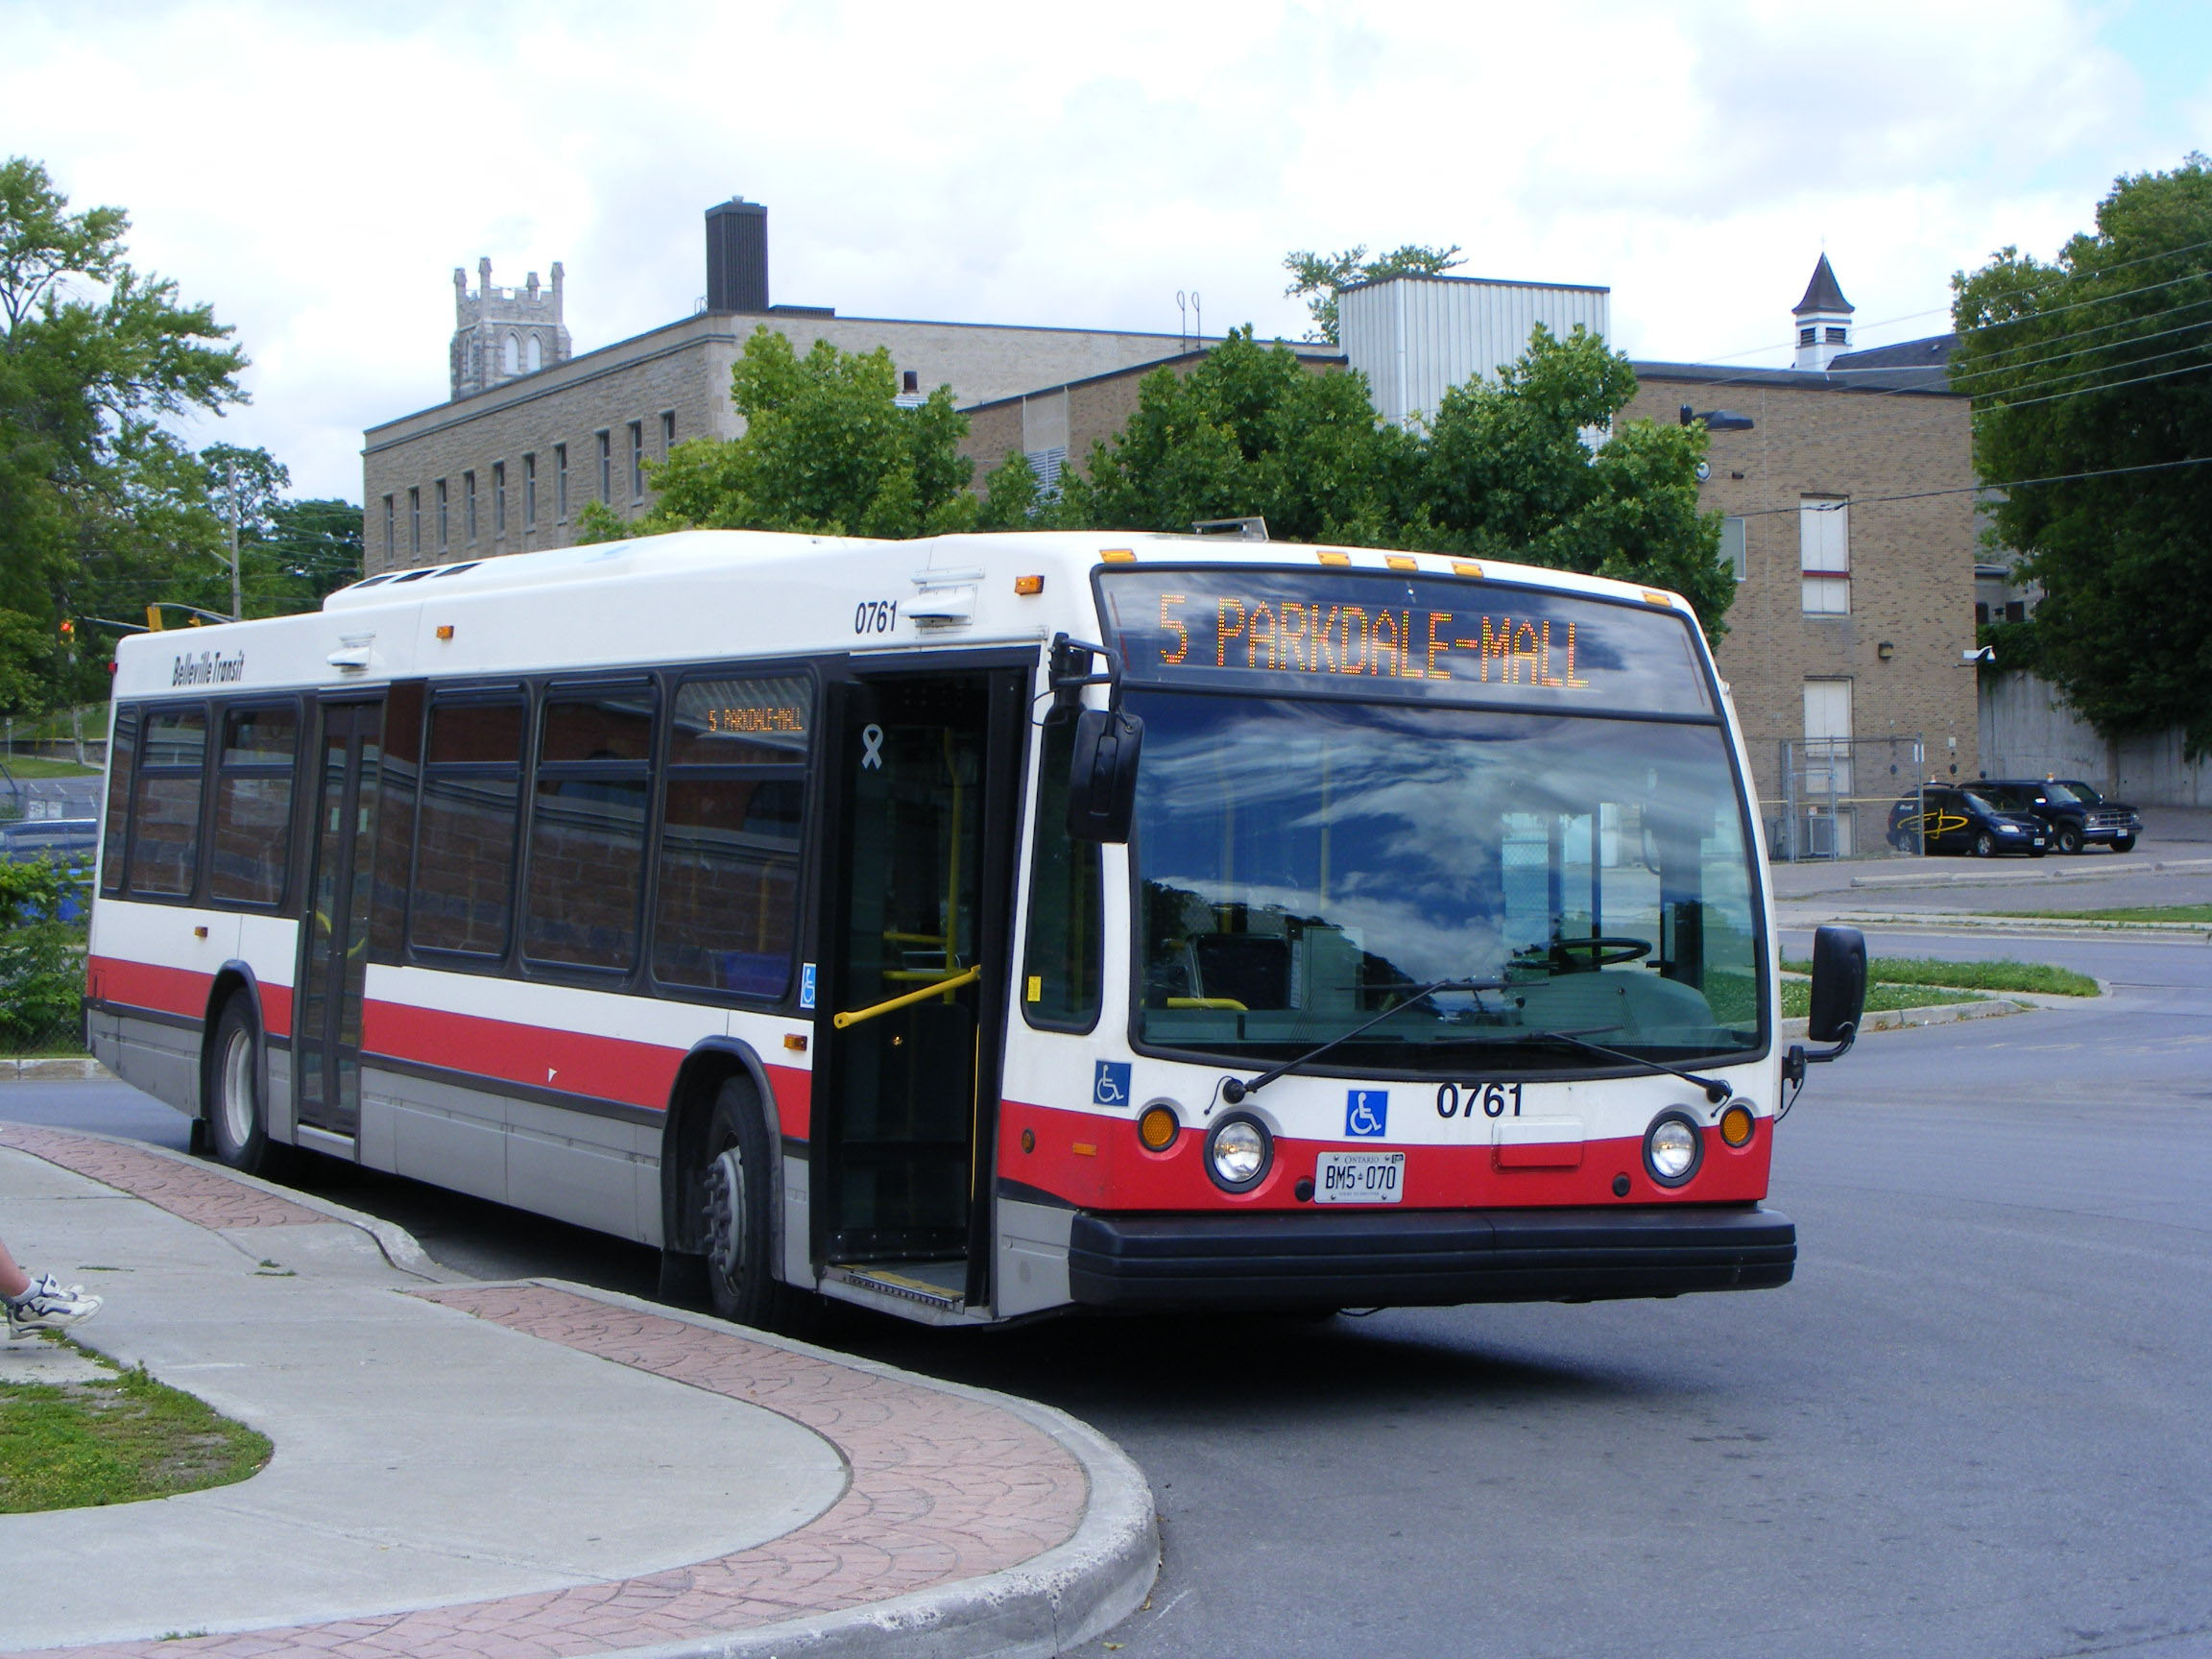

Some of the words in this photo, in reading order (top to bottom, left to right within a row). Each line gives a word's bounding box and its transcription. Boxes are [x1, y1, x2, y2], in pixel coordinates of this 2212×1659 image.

[854, 600, 898, 635] 0761
[1160, 594, 1189, 664] 5
[1216, 597, 1590, 689] PARKDALE-MALL
[172, 651, 212, 686] Belleville
[212, 650, 245, 684] Transit
[709, 709, 718, 732] 5
[1436, 1083, 1523, 1118] 0761
